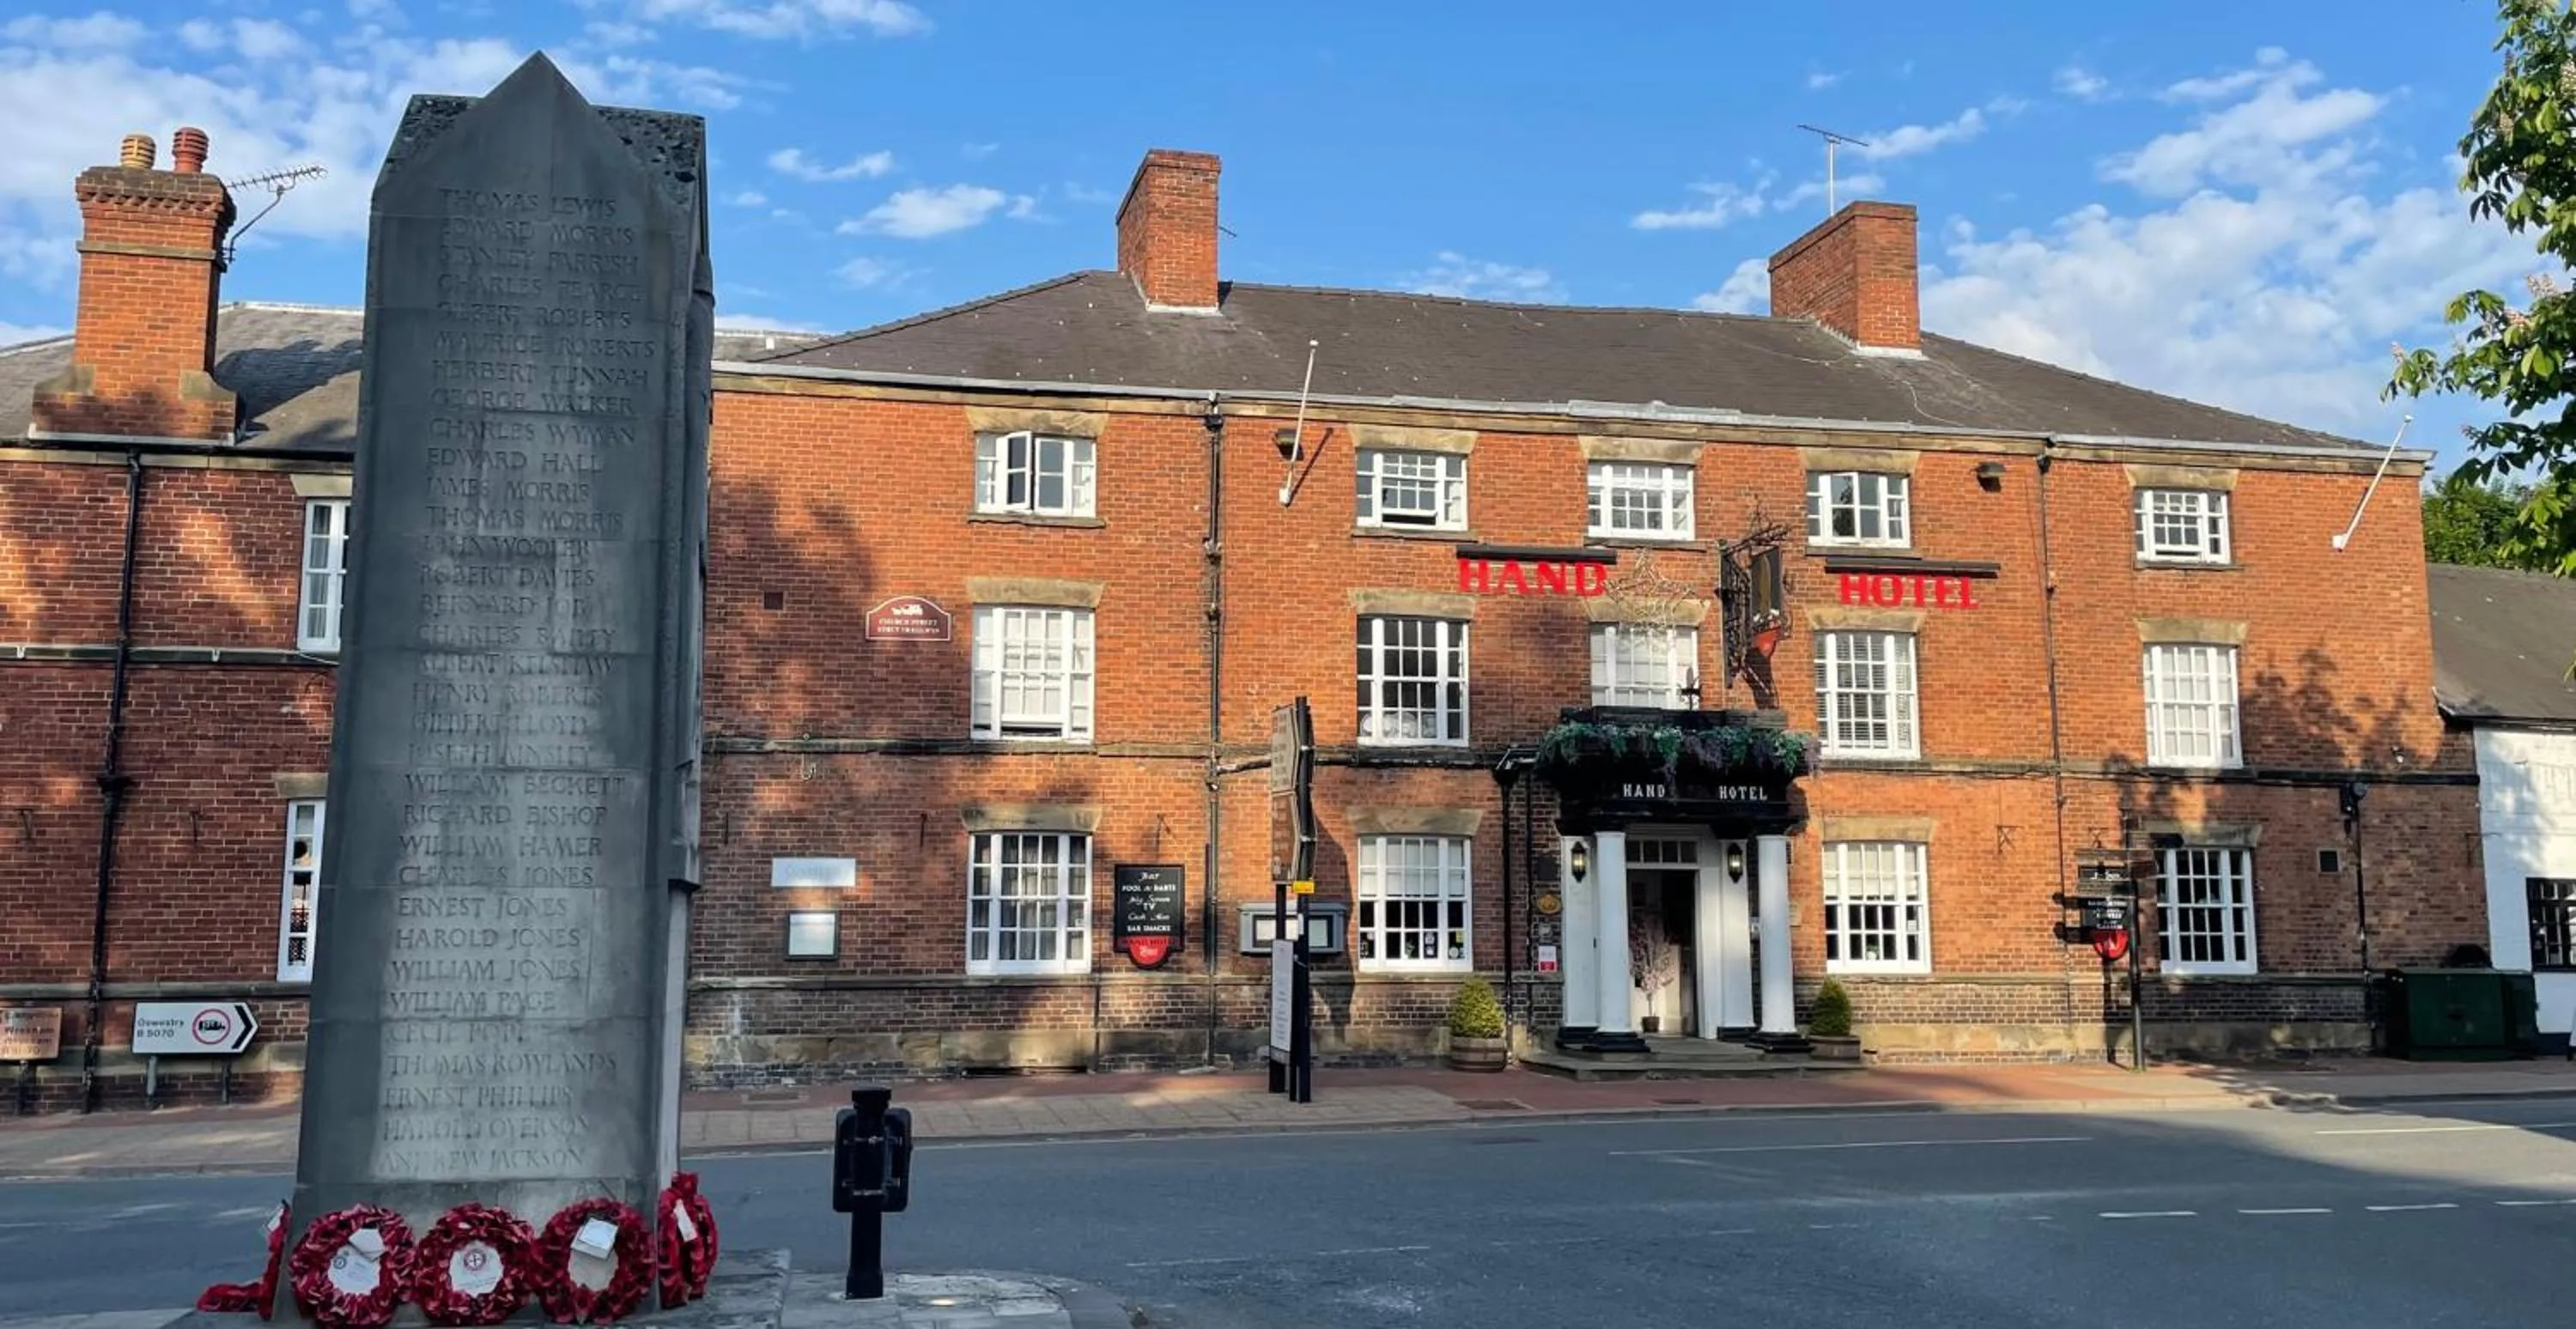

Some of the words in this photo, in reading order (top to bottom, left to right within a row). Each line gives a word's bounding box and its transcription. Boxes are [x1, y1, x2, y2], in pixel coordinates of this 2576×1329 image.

[440, 189, 538, 209] THOMAS
[550, 197, 617, 217] LEWIS
[440, 218, 534, 240] EDWARD
[550, 225, 635, 245] MORRIS
[439, 246, 534, 268] STANLEY
[437, 274, 542, 295] CHARLES
[538, 308, 631, 329] ROBERTS
[552, 336, 655, 358] ROBERTS
[432, 361, 538, 383] HERBERT
[550, 365, 649, 388] TUNNAH
[431, 387, 527, 409] GEORGE
[541, 393, 634, 416] WALKER
[430, 418, 535, 440] CHARLES
[546, 423, 636, 446] WYMAN
[428, 448, 527, 470] EDWARD
[542, 453, 604, 472] HALL
[428, 476, 489, 497] JAMES
[505, 482, 590, 502] MORRIS
[426, 507, 525, 528] THOMAS
[542, 511, 624, 533] MORRIS
[420, 565, 511, 586] ROBERT
[519, 567, 595, 589] DAVIES
[1458, 558, 1610, 598] HAND
[1838, 572, 1979, 610] HOTEL
[417, 624, 522, 646] CHARLES
[412, 683, 490, 704] HENRY
[505, 686, 603, 707] ROBERTS
[513, 714, 591, 736] LLOYD
[408, 743, 491, 764] JOSEPH
[405, 774, 509, 796] WILLIAM
[524, 777, 626, 796] BECKETT
[1622, 783, 1667, 798] HAND
[1719, 785, 1768, 800] HOTEL
[404, 805, 512, 825] RICHARD
[526, 807, 608, 826] BISHOP
[399, 835, 505, 857] WILLIAM
[519, 836, 603, 857] HAMER
[398, 866, 508, 887] CHARLES
[525, 867, 594, 886] JONES
[398, 897, 486, 919] ERNEST
[495, 897, 568, 919] JONES
[1143, 902, 1156, 911] TV
[396, 928, 499, 950] HAROLD
[506, 928, 580, 950] JONES
[392, 960, 495, 981] WILLIAM
[503, 960, 580, 980] JONES
[390, 991, 488, 1012] WILLIAM
[498, 992, 556, 1012] PAGE
[137, 1016, 185, 1029] Oswestry
[147, 1029, 174, 1038] 5070
[387, 1054, 485, 1076] THOMAS
[494, 1053, 617, 1075] ROWLANDS
[384, 1087, 467, 1109] ERNEST
[478, 1085, 574, 1108] PHILLIPS
[383, 1120, 481, 1141] HAROLD
[380, 1151, 485, 1174] ANDREW
[489, 1149, 584, 1170] JACKSON
